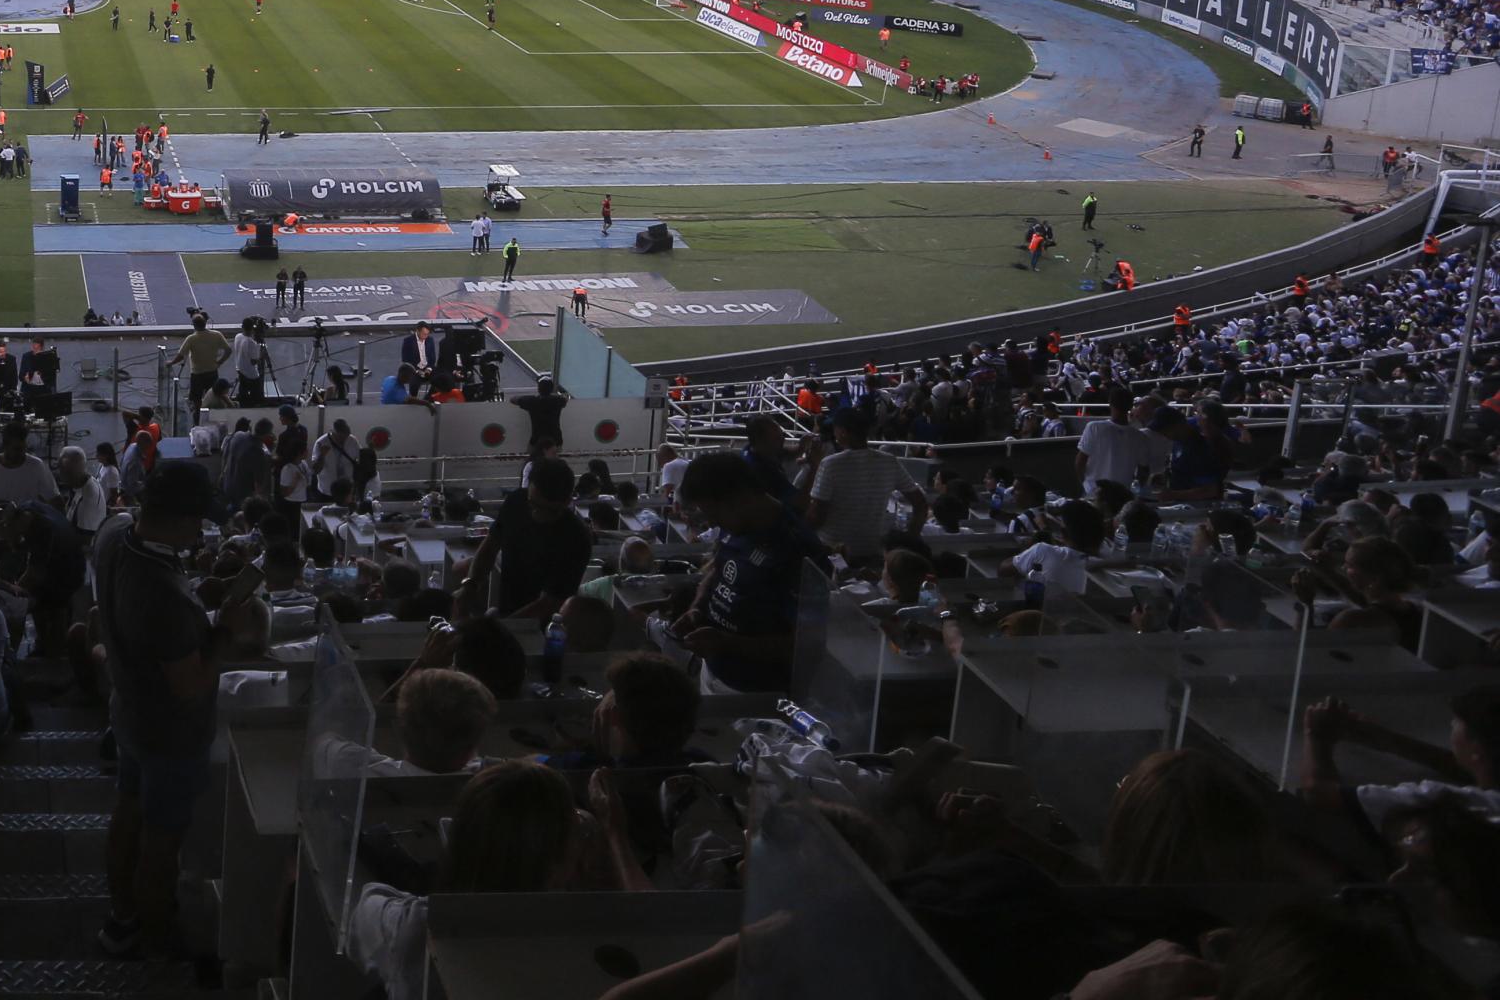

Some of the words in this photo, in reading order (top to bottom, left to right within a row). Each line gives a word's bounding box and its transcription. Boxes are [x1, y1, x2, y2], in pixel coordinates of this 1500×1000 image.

[698, 8, 758, 43] sicaelec.com
[824, 11, 842, 22] Del
[843, 13, 870, 25] Pilar
[893, 17, 936, 30] CADENA
[783, 46, 844, 81] Betano
[865, 59, 900, 86] Schneider
[341, 180, 424, 194] HOLCIM
[305, 226, 401, 234] GATORADE
[128, 270, 151, 302] TALLERES
[464, 277, 638, 293] MONTIRONI
[664, 302, 776, 314] HOLCIM
[715, 581, 737, 603] ICBC
